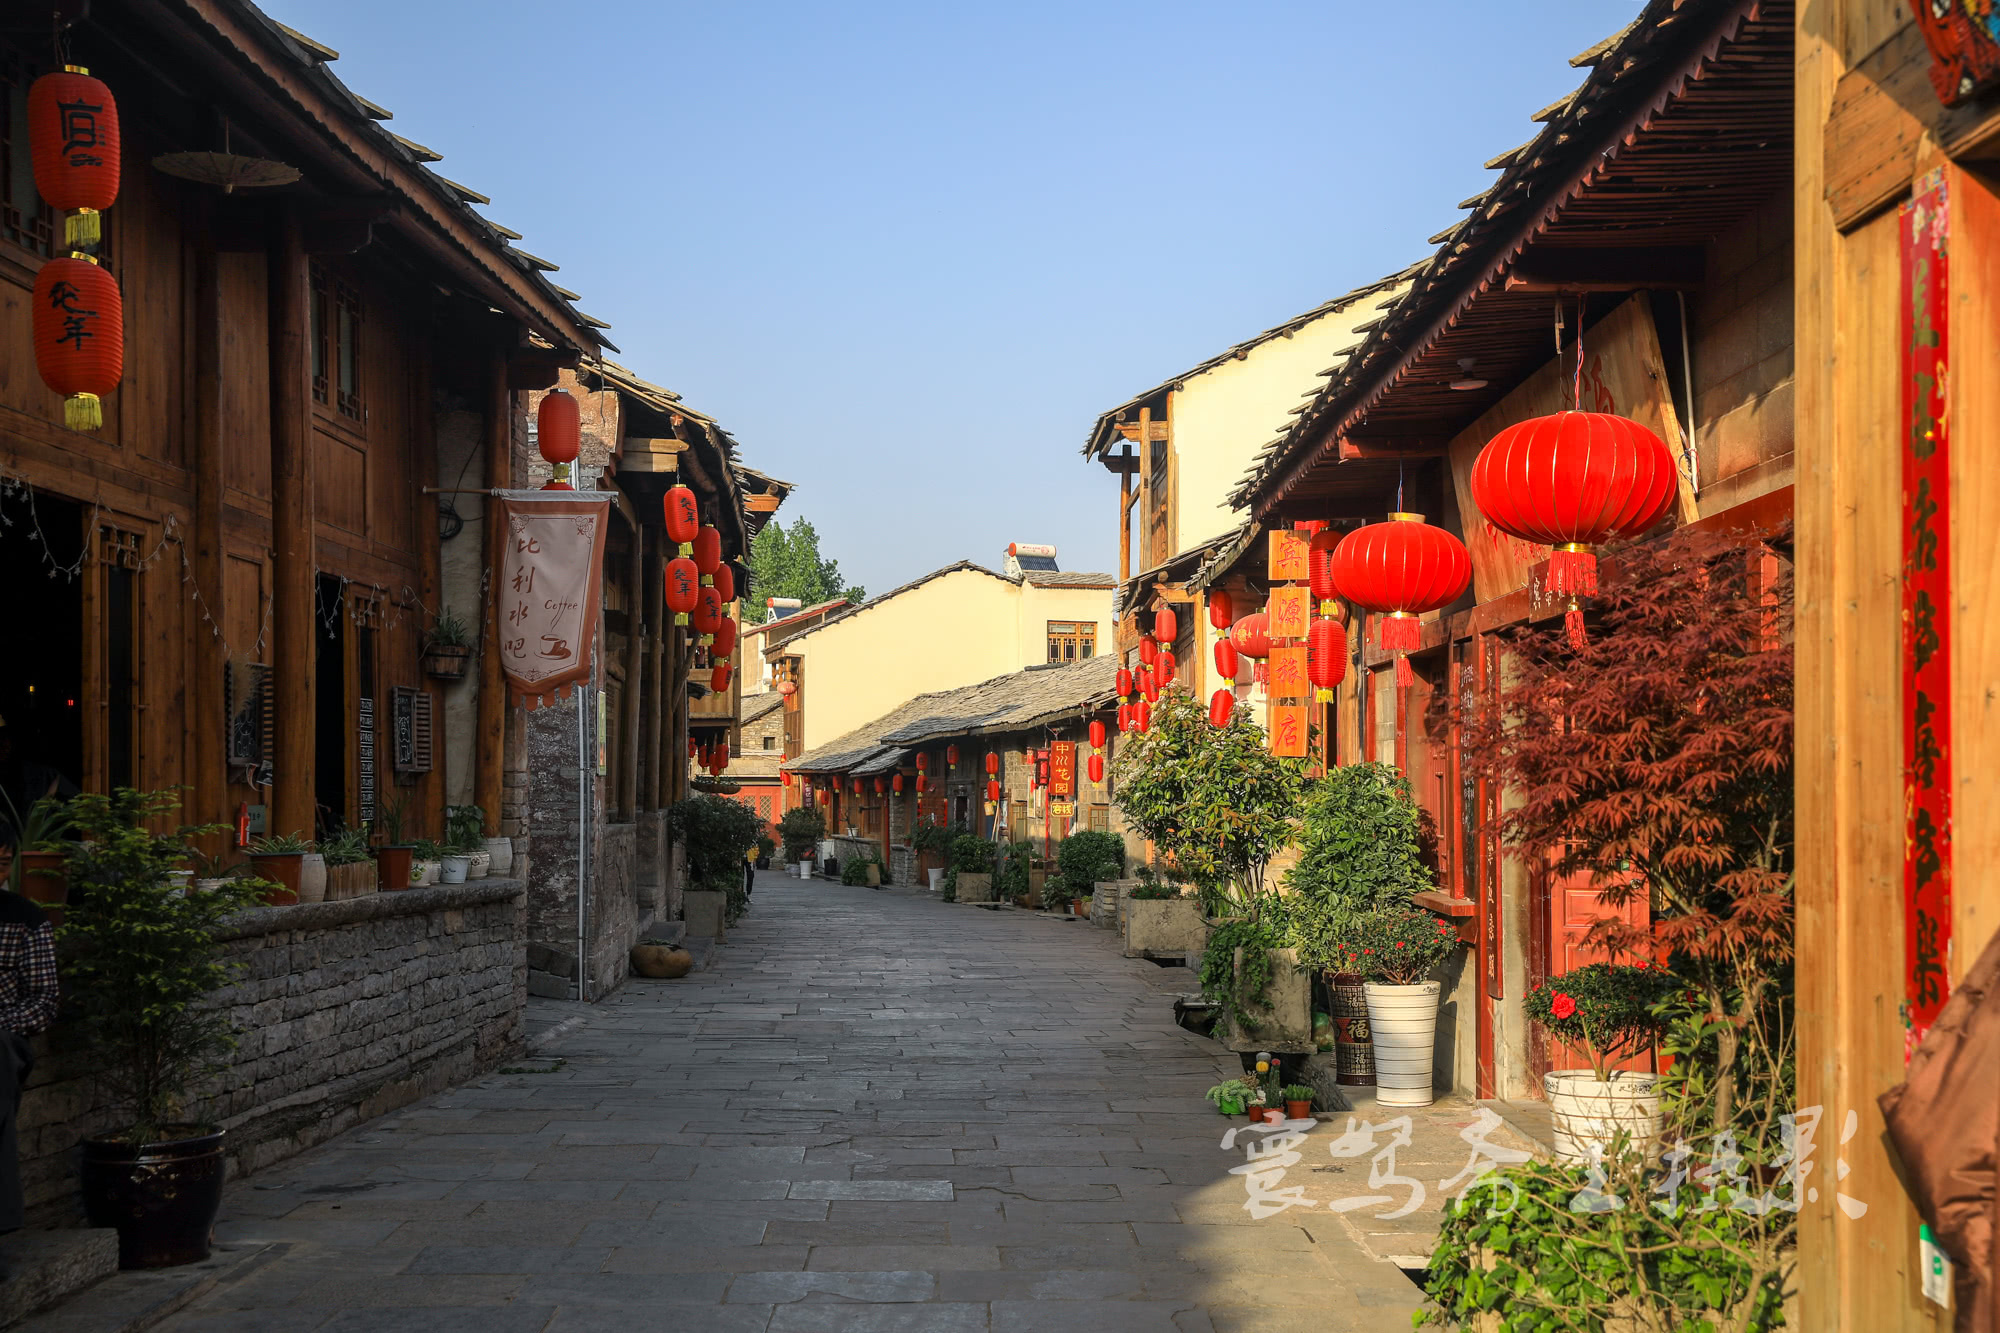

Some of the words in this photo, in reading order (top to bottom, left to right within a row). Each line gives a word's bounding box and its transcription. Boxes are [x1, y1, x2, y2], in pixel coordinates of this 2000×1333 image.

[504, 536, 541, 659] 比利水吧
[544, 597, 578, 618] Coffee
[1275, 538, 1303, 747] 宾源旅店
[1056, 743, 1071, 793] 中川花园
[1052, 804, 1072, 815] 客栈
[1347, 1020, 1369, 1039] 福
